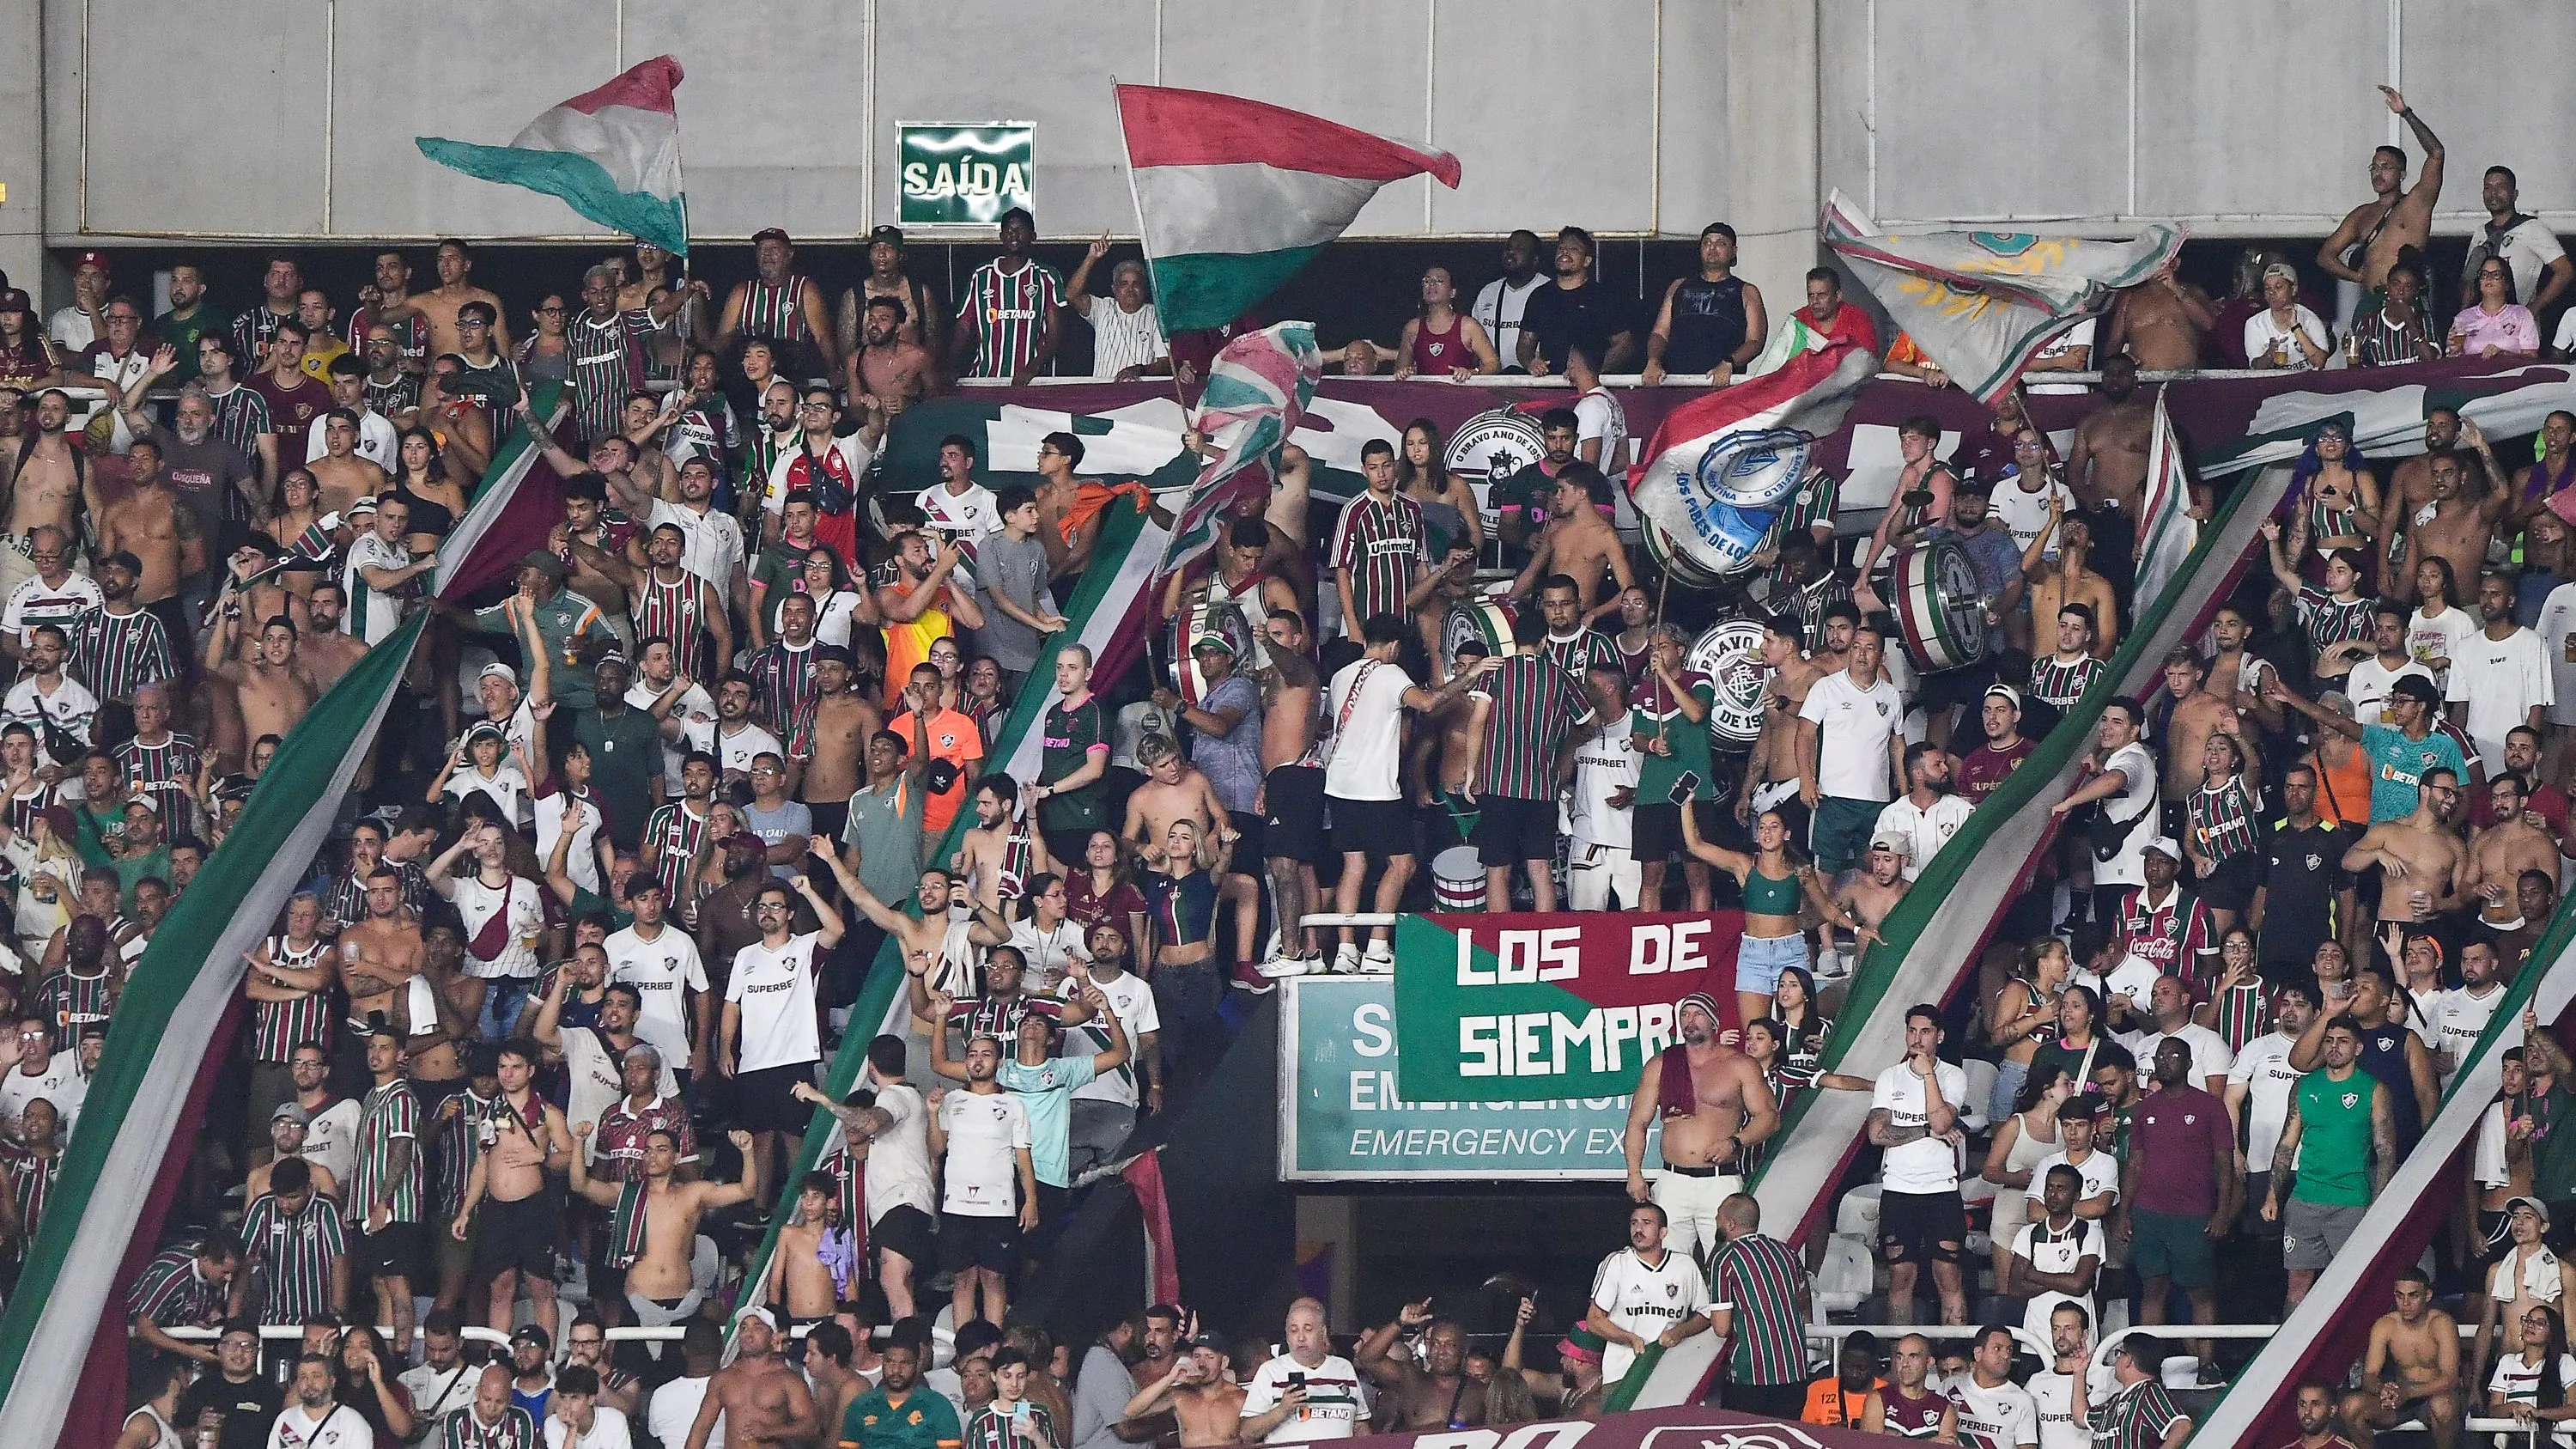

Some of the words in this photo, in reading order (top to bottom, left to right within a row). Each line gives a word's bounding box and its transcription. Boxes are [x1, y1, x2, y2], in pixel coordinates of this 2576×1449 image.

[904, 155, 1026, 196] SAÍDA
[998, 309, 1036, 320] BETANO
[576, 350, 621, 366] SUPERBET
[1461, 432, 1490, 455] BRAVO
[1492, 430, 1514, 441] ANO
[1516, 435, 1528, 447] DE
[1527, 445, 1542, 461] 195
[1685, 497, 1711, 538] PIBES
[1707, 533, 1728, 551] DE
[1726, 543, 1746, 561] LO
[1371, 540, 1413, 555] Unimed
[1700, 636, 1753, 673] BRAVO
[1719, 709, 1740, 727] DE
[1578, 757, 1626, 769] SUPERBET
[2393, 770, 2420, 787] BETA
[2208, 816, 2246, 838] BETANO
[1456, 926, 1582, 987] LOS
[1629, 918, 1712, 977] DE
[2129, 937, 2178, 960] Coca-Cola
[1460, 998, 1686, 1078] SIEMPR
[2269, 1069, 2301, 1081] SUPE
[1893, 1110, 1925, 1123] SUPER
[1349, 1128, 1577, 1158] EMERGENCY
[1584, 1128, 1659, 1157] EXT
[1625, 1302, 1684, 1320] unimed
[1310, 1407, 1352, 1421] BETANO
[2040, 1412, 2072, 1422] SUPER
